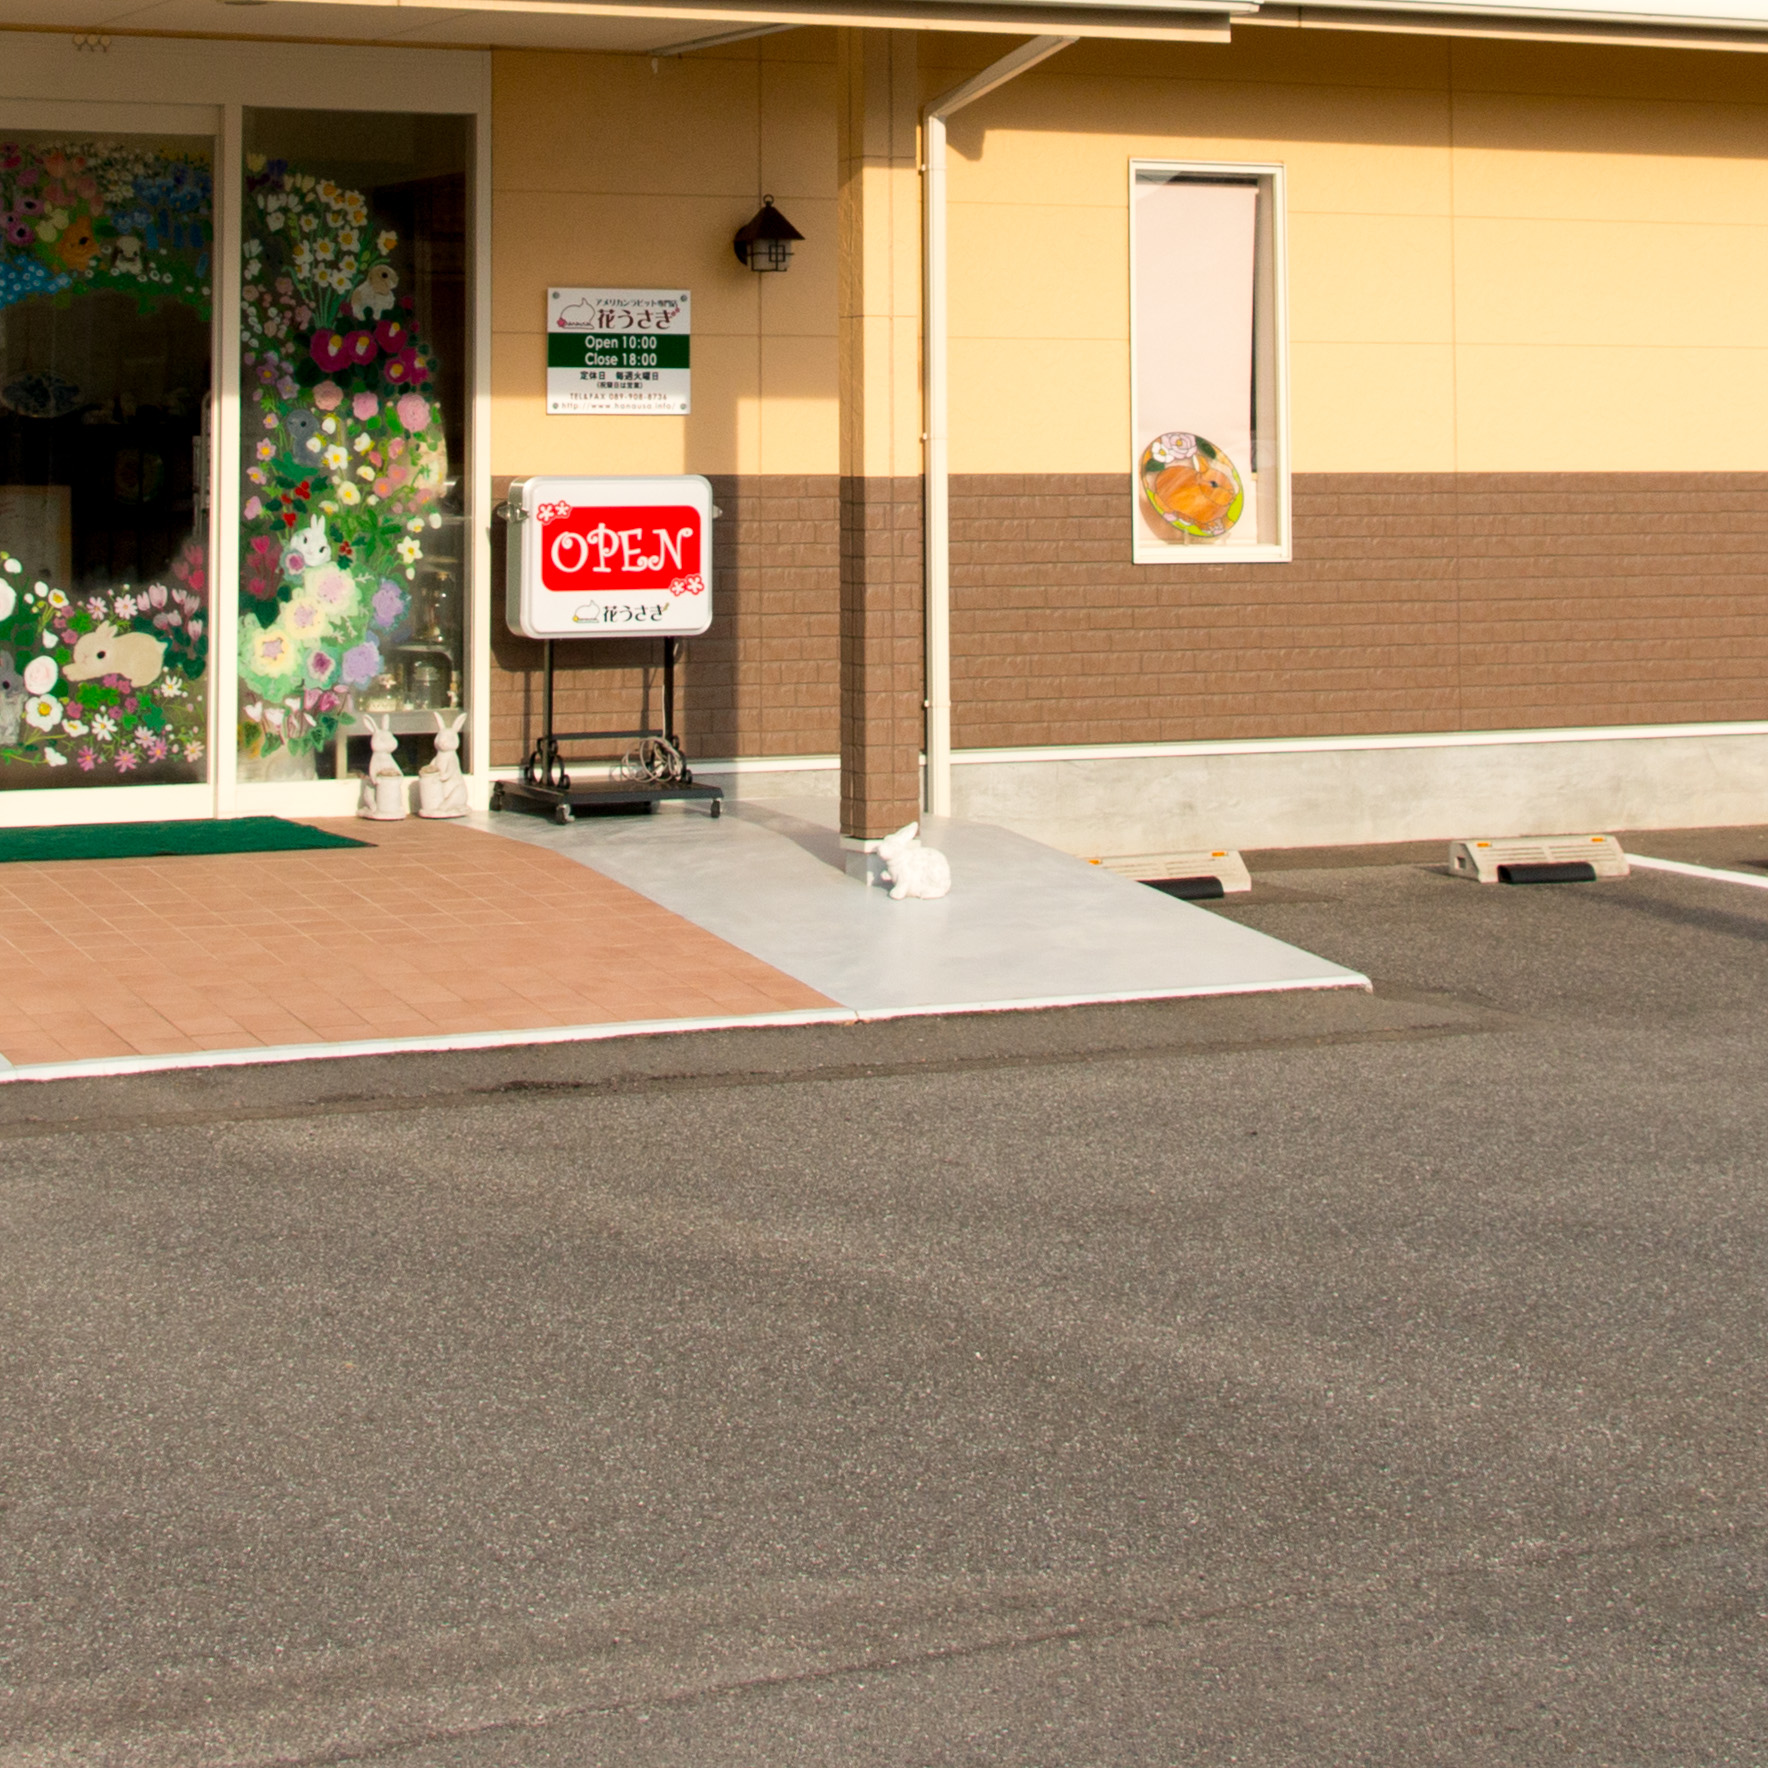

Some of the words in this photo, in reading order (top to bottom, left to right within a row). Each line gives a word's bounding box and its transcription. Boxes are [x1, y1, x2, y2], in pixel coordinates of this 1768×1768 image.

[598, 307, 679, 330] 花うさぎ
[585, 335, 619, 351] Open
[622, 335, 657, 349] 10:00
[584, 352, 619, 366] Close
[622, 353, 657, 367] 18:00
[580, 371, 606, 381] 定休日
[551, 523, 693, 573] OPEN
[603, 602, 670, 623] 花うさぎ
